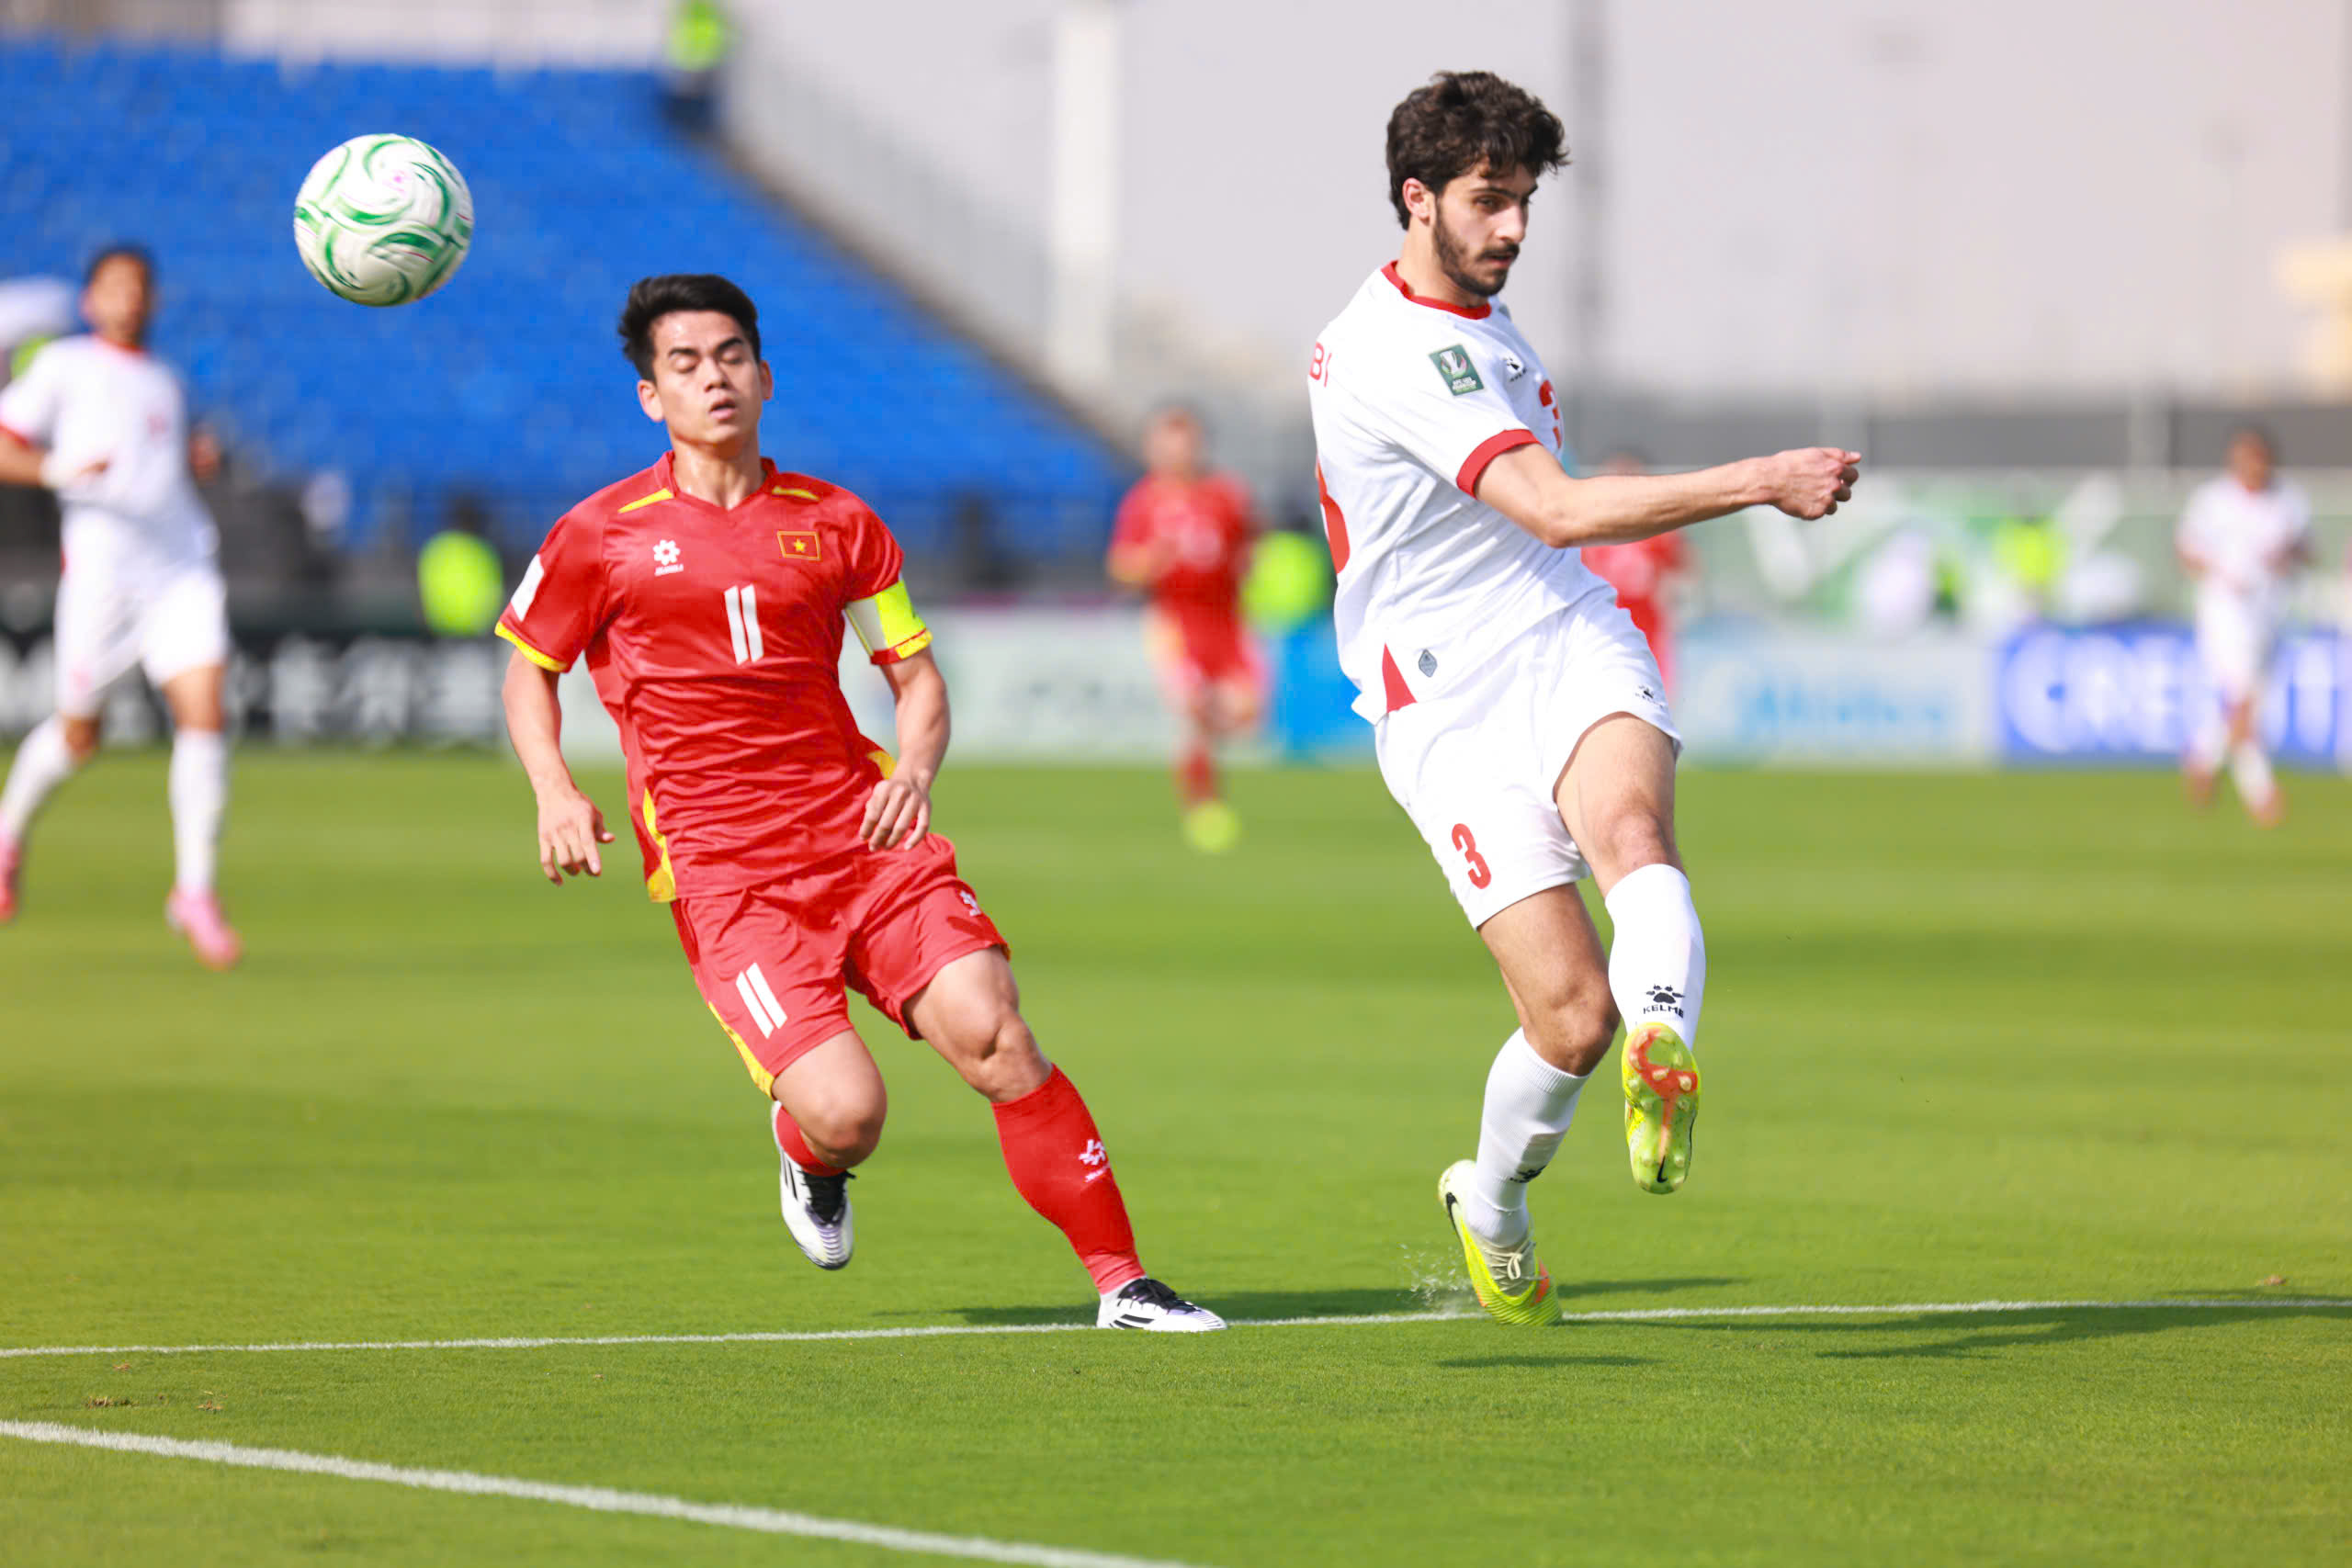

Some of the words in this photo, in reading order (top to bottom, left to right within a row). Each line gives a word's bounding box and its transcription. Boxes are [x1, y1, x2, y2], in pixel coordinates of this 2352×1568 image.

[724, 583, 764, 665] 11
[1451, 822, 1492, 890] 3
[735, 962, 788, 1040] 11
[1643, 1004, 1684, 1019] KELME
